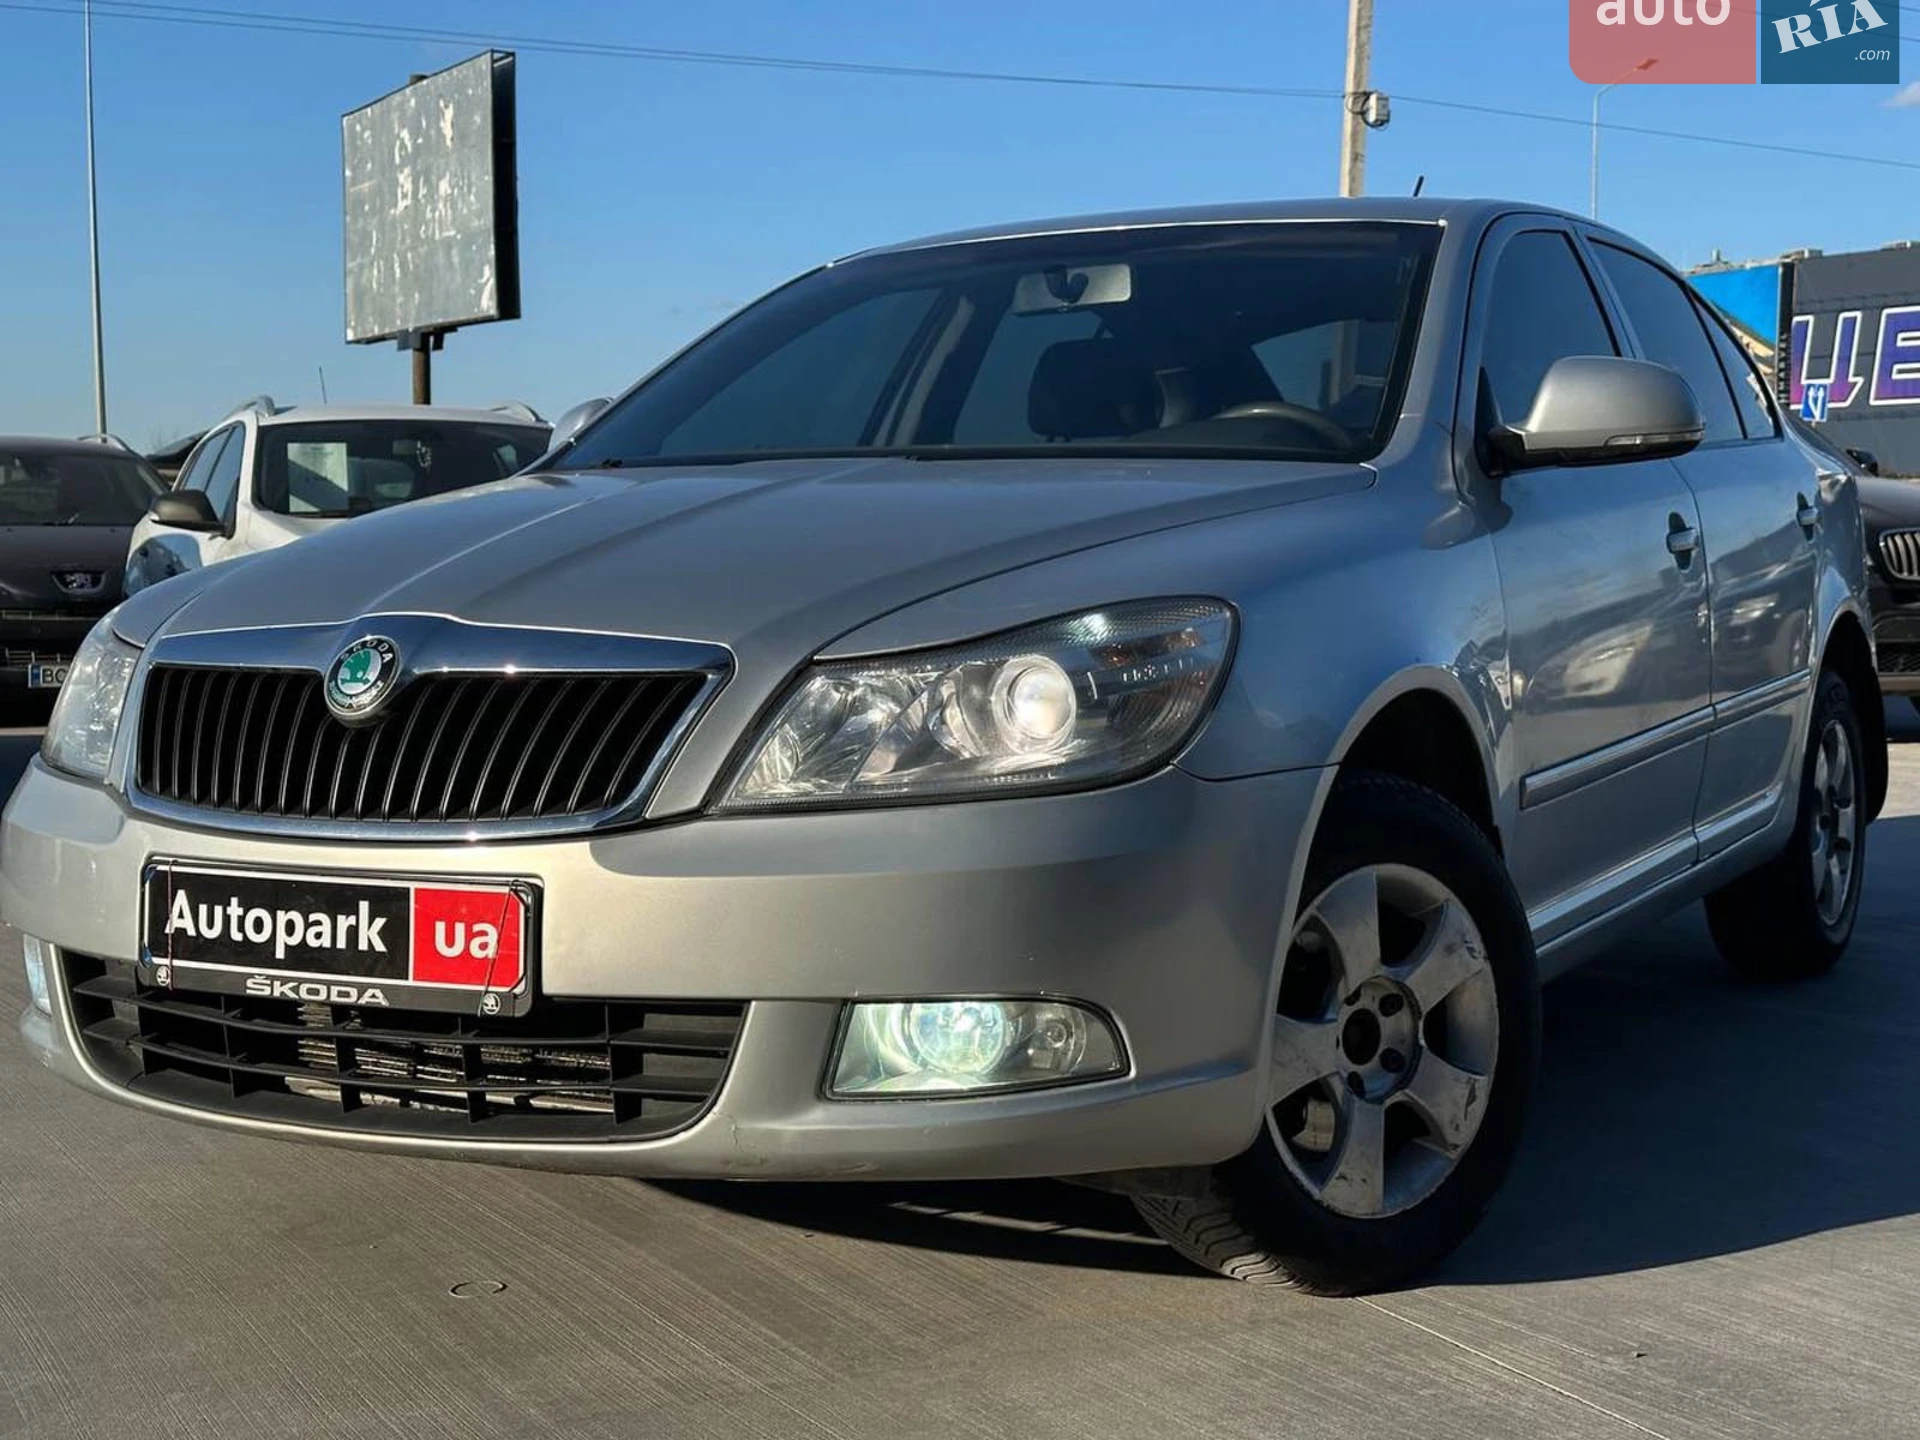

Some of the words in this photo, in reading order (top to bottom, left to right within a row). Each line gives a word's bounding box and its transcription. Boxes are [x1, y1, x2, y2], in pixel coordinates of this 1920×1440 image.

[164, 888, 388, 960] Autopark
[434, 918, 499, 959] ua
[245, 974, 390, 1007] ŠKODA
